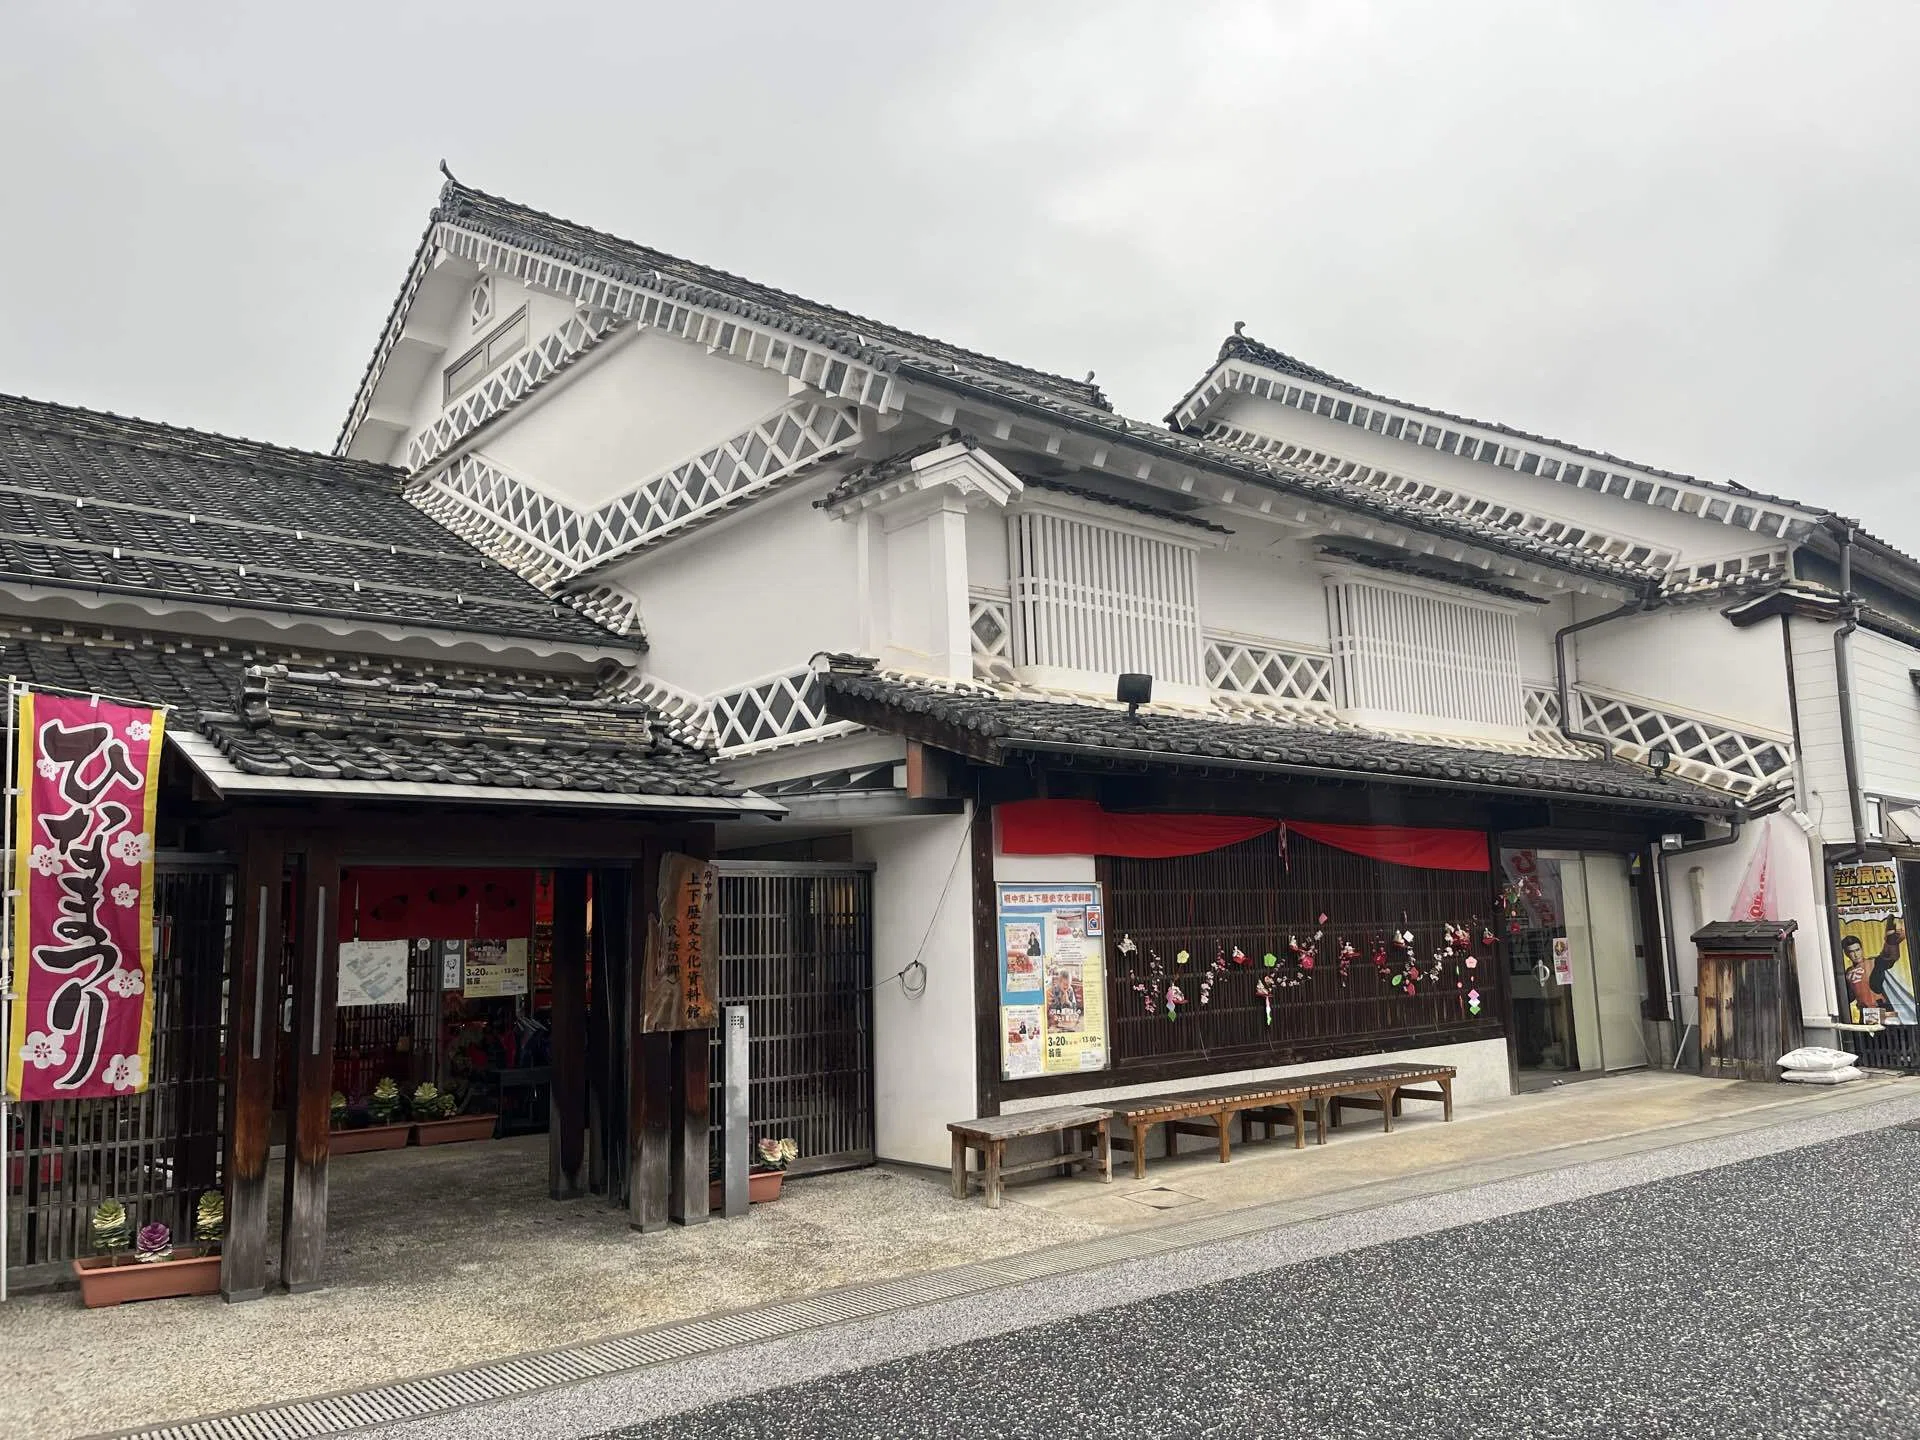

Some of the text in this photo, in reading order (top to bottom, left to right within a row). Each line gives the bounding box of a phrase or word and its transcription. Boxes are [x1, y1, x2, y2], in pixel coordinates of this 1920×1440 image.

[36, 720, 143, 1088] ひなまつり
[686, 872, 701, 1020] 上下歴史文化資料館
[704, 869, 713, 903] 府中市
